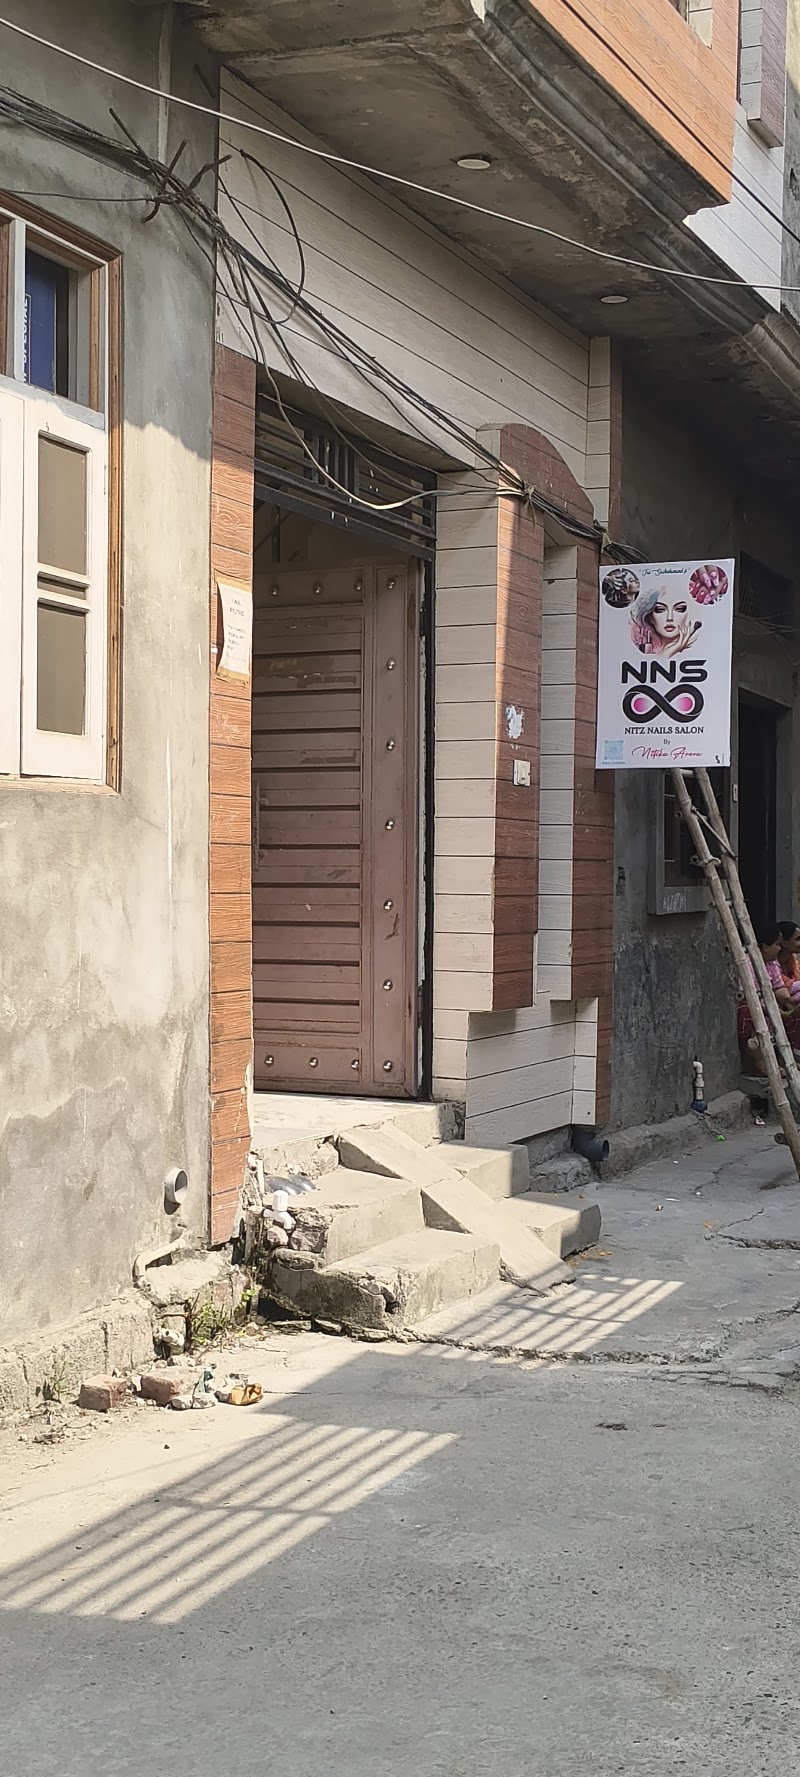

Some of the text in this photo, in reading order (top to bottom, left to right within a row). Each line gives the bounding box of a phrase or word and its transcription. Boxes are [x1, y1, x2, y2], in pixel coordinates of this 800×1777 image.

[621, 660, 708, 683] NNS
[624, 726, 704, 735] NITZ NAILS SALON
[663, 738, 671, 746] By
[670, 746, 703, 760] Arora
